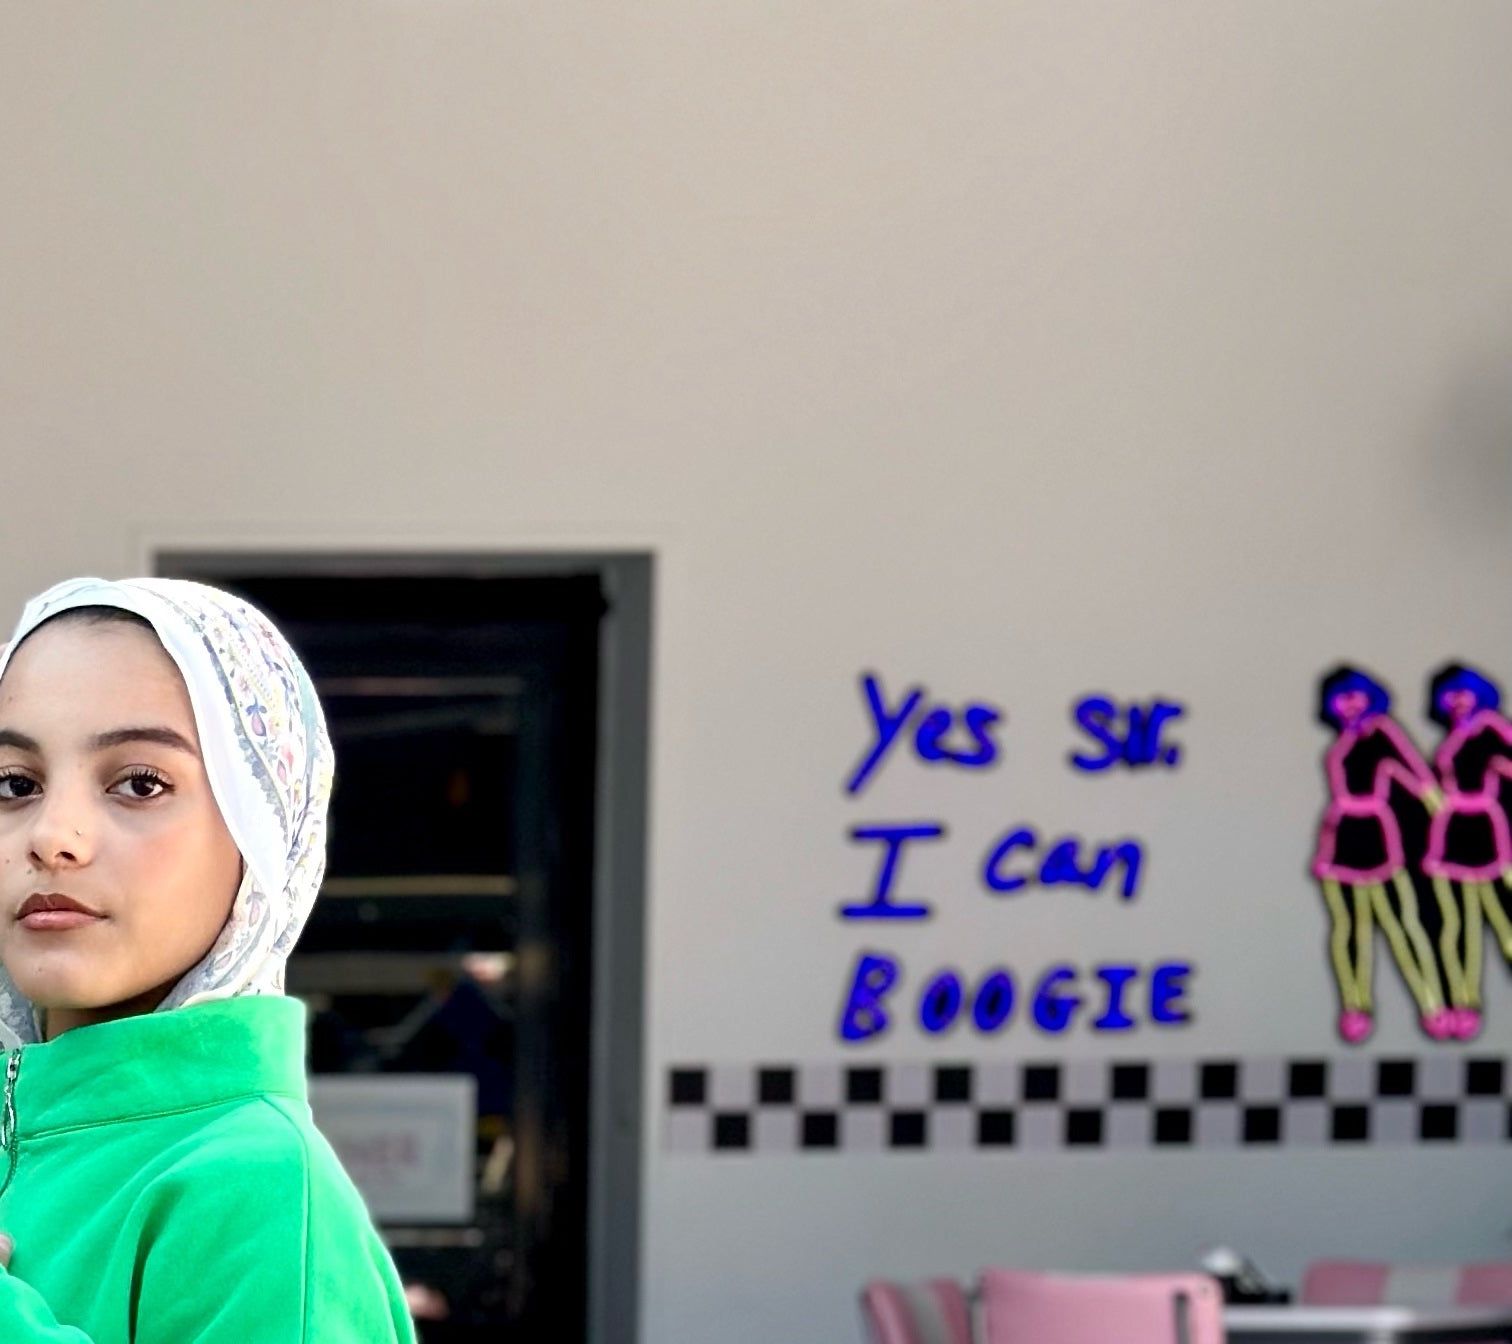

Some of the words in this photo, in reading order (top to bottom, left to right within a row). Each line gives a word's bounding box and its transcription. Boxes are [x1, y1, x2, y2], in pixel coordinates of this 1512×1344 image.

[846, 674, 1000, 793] Yes
[840, 822, 942, 920] I
[838, 954, 1192, 1044] BOOGIE
